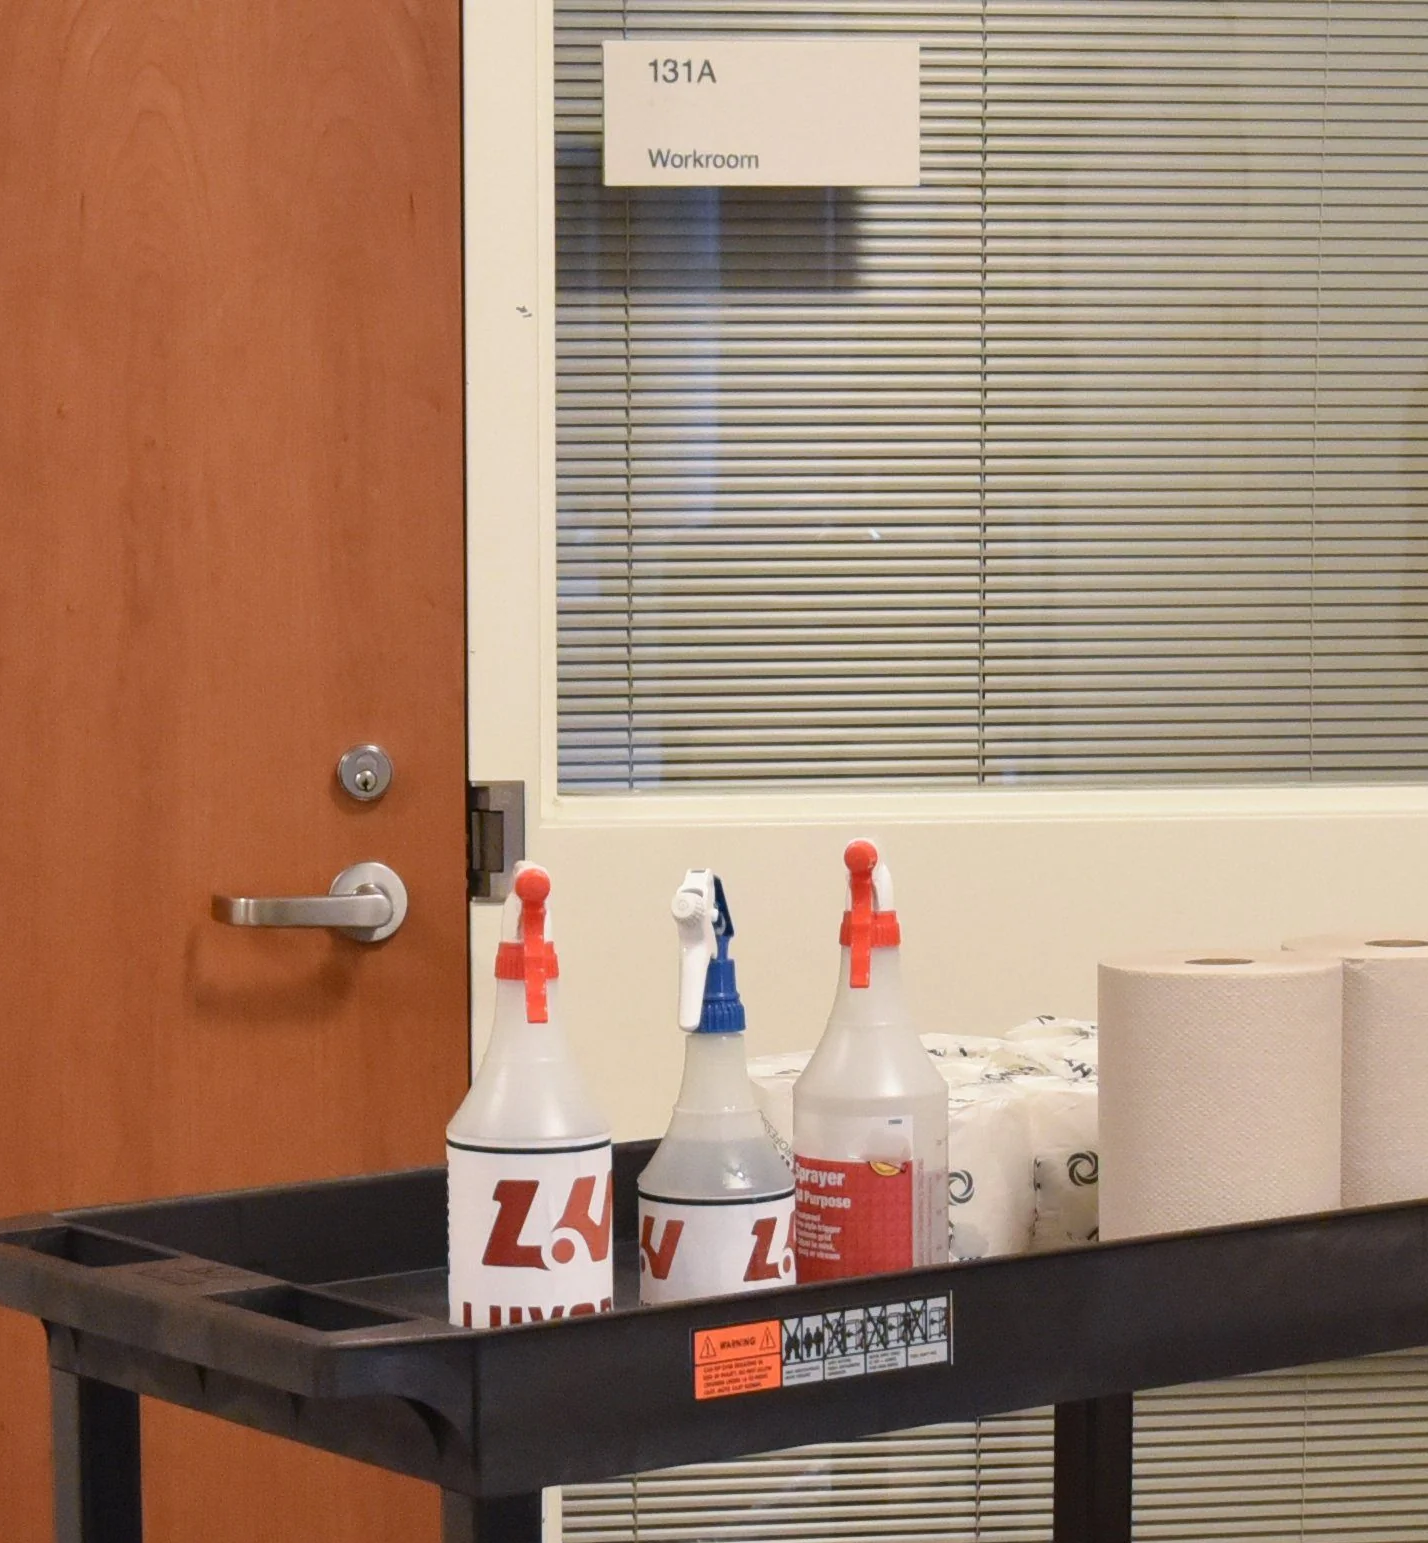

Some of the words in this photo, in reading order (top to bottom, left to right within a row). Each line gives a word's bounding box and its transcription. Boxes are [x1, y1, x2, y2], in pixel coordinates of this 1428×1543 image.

[647, 58, 717, 84] 131A
[647, 148, 760, 170] Workroom
[804, 1190, 852, 1210] Purpose
[719, 1336, 757, 1350] WARNING
